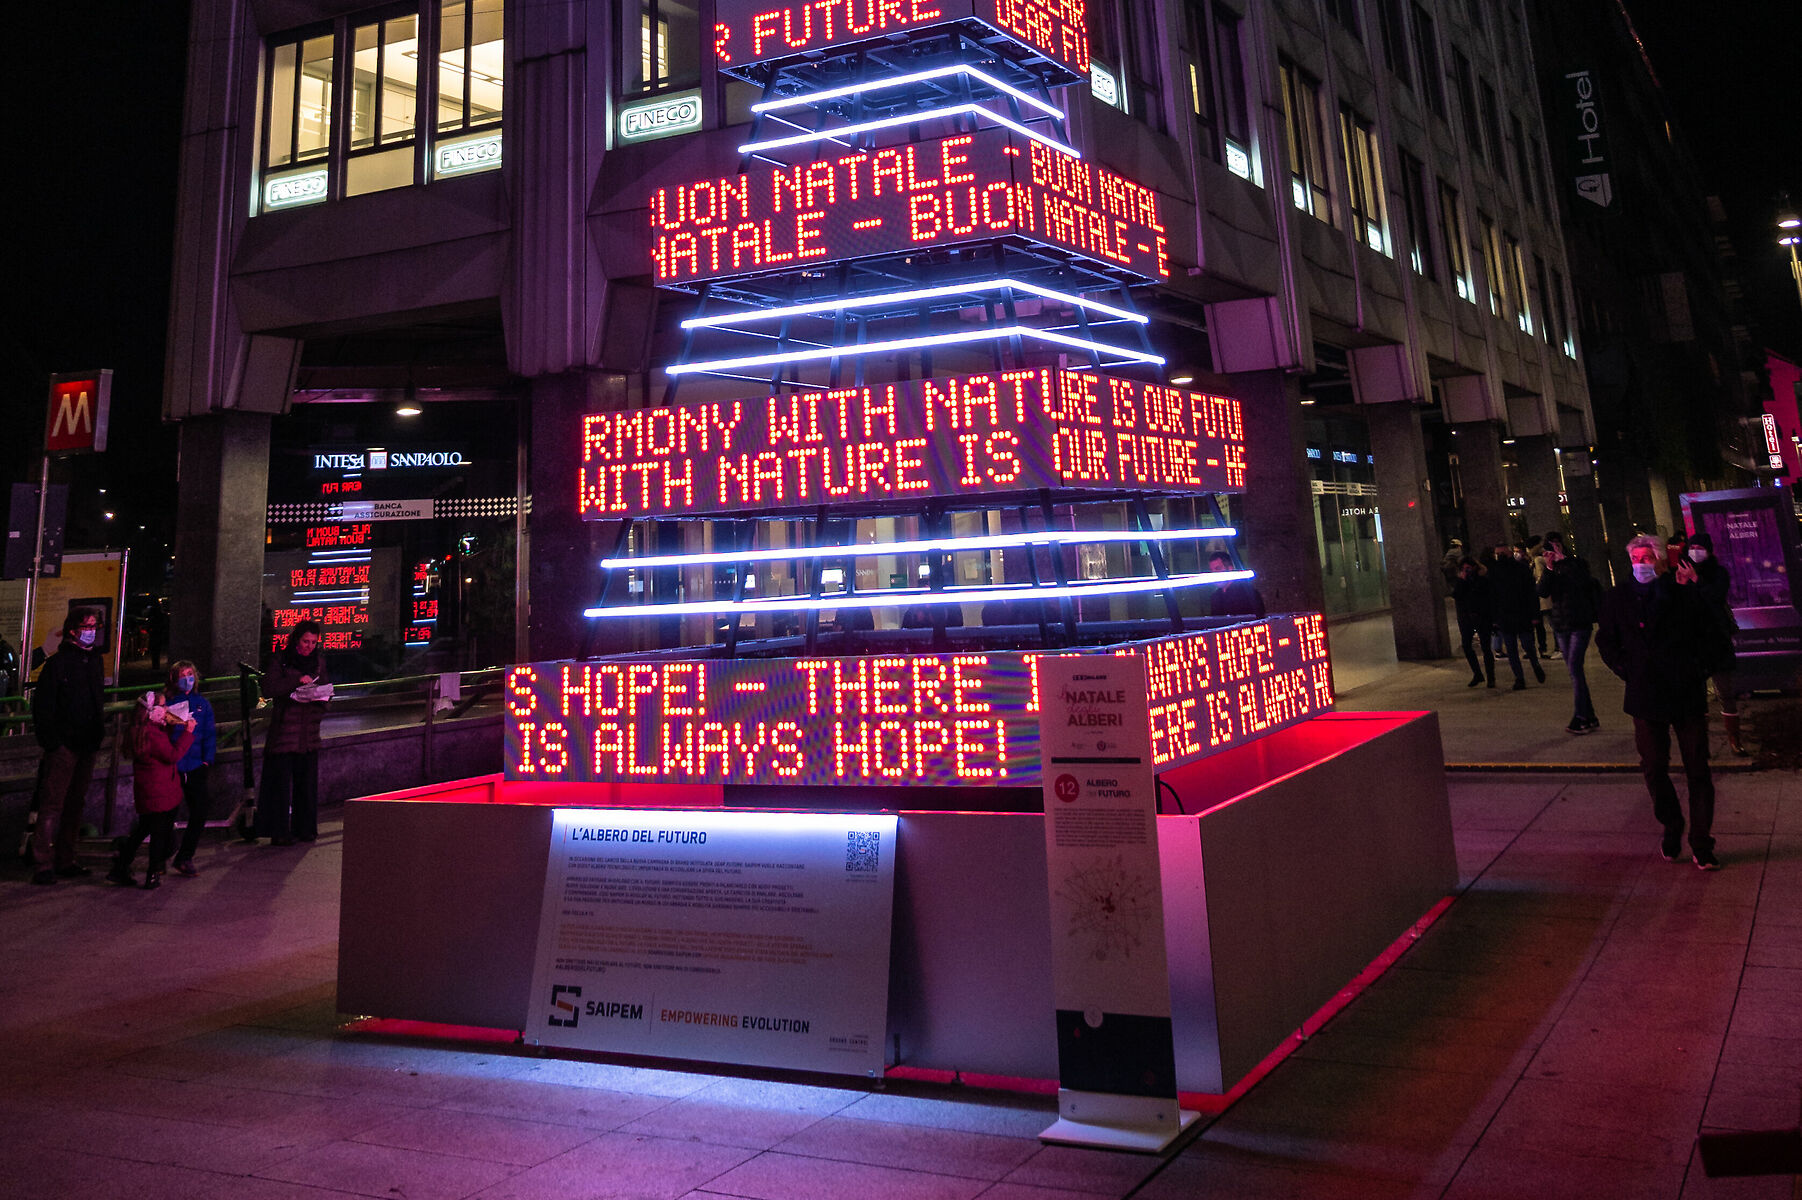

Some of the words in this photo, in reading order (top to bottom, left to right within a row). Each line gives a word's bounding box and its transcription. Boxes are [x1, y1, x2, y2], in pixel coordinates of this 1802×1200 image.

[628, 104, 692, 130] FINECO
[443, 142, 499, 168] FINECO
[650, 173, 750, 230] UON
[773, 135, 976, 213] NATALE
[1030, 139, 1092, 205] BUON
[1098, 169, 1165, 234] NATAL
[909, 181, 1035, 242] BUON
[1043, 193, 1131, 264] NATALE
[51, 391, 92, 437] M
[583, 400, 742, 462] RMONY
[768, 384, 896, 445] WITH
[924, 368, 1102, 432] NATURE
[1109, 378, 1136, 429] IS
[1144, 384, 1186, 435] OUR
[1190, 392, 1244, 441] FUTU
[314, 453, 365, 469] INTESA
[390, 452, 463, 467] SANPAOLO
[578, 457, 694, 514] WITH
[718, 437, 930, 504] NATURE
[958, 429, 1021, 487] IS
[1051, 426, 1110, 481] OUR
[1117, 432, 1202, 485] FUTURE
[354, 509, 421, 520] ASSICURAZIONE
[374, 502, 402, 511] BANCA
[1727, 521, 1758, 530] NATALE
[1146, 636, 1211, 701] WAYS
[1215, 623, 1275, 684] HOPE!
[508, 666, 537, 717] S
[562, 662, 706, 717] HOPE!
[796, 653, 991, 715] THERE
[1066, 689, 1126, 704] NATALE
[1067, 713, 1123, 727] ALBERI
[1149, 698, 1201, 765] ERE
[1206, 689, 1233, 746] IS
[1238, 668, 1310, 736] ALWAYS
[518, 721, 567, 774] IS
[594, 720, 804, 777] ALWAYS
[834, 718, 1009, 778] HOPE!
[1059, 781, 1077, 796] 12
[1086, 779, 1118, 788] ALBERO
[1098, 790, 1131, 798] FUTURO
[571, 827, 628, 843] L'ALBERO
[632, 830, 655, 844] DEL
[658, 831, 708, 845] FUTURO
[585, 1000, 644, 1021] SAIPEM
[660, 1008, 739, 1029] EMPOWERING
[742, 1015, 810, 1034] EVOLUTION
